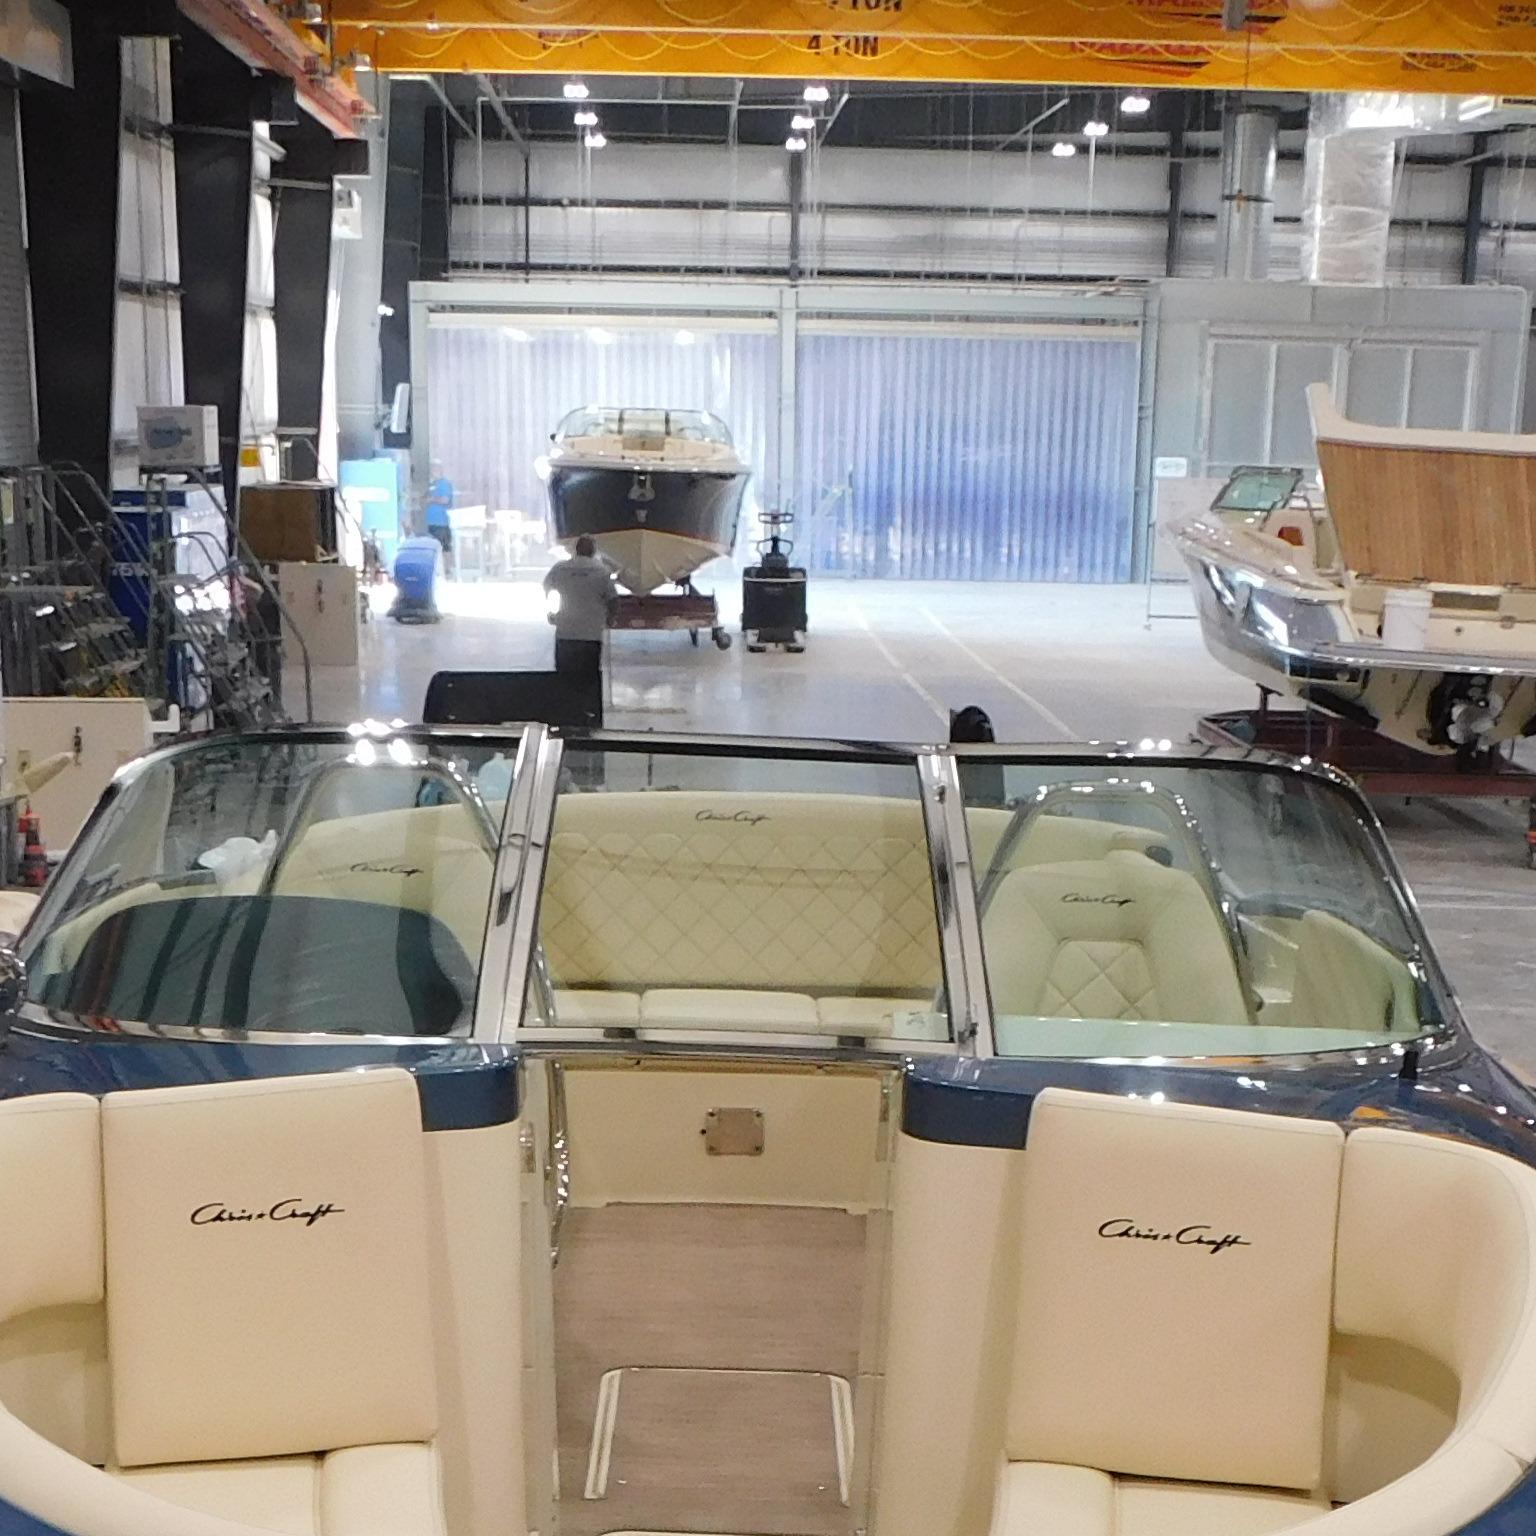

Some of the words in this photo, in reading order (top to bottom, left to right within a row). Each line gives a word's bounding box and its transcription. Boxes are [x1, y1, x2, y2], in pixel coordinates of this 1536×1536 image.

[191, 1202, 253, 1226] Chris
[269, 1198, 346, 1227] Craft
[1098, 1218, 1159, 1240] Chris
[1175, 1225, 1252, 1255] Craft
